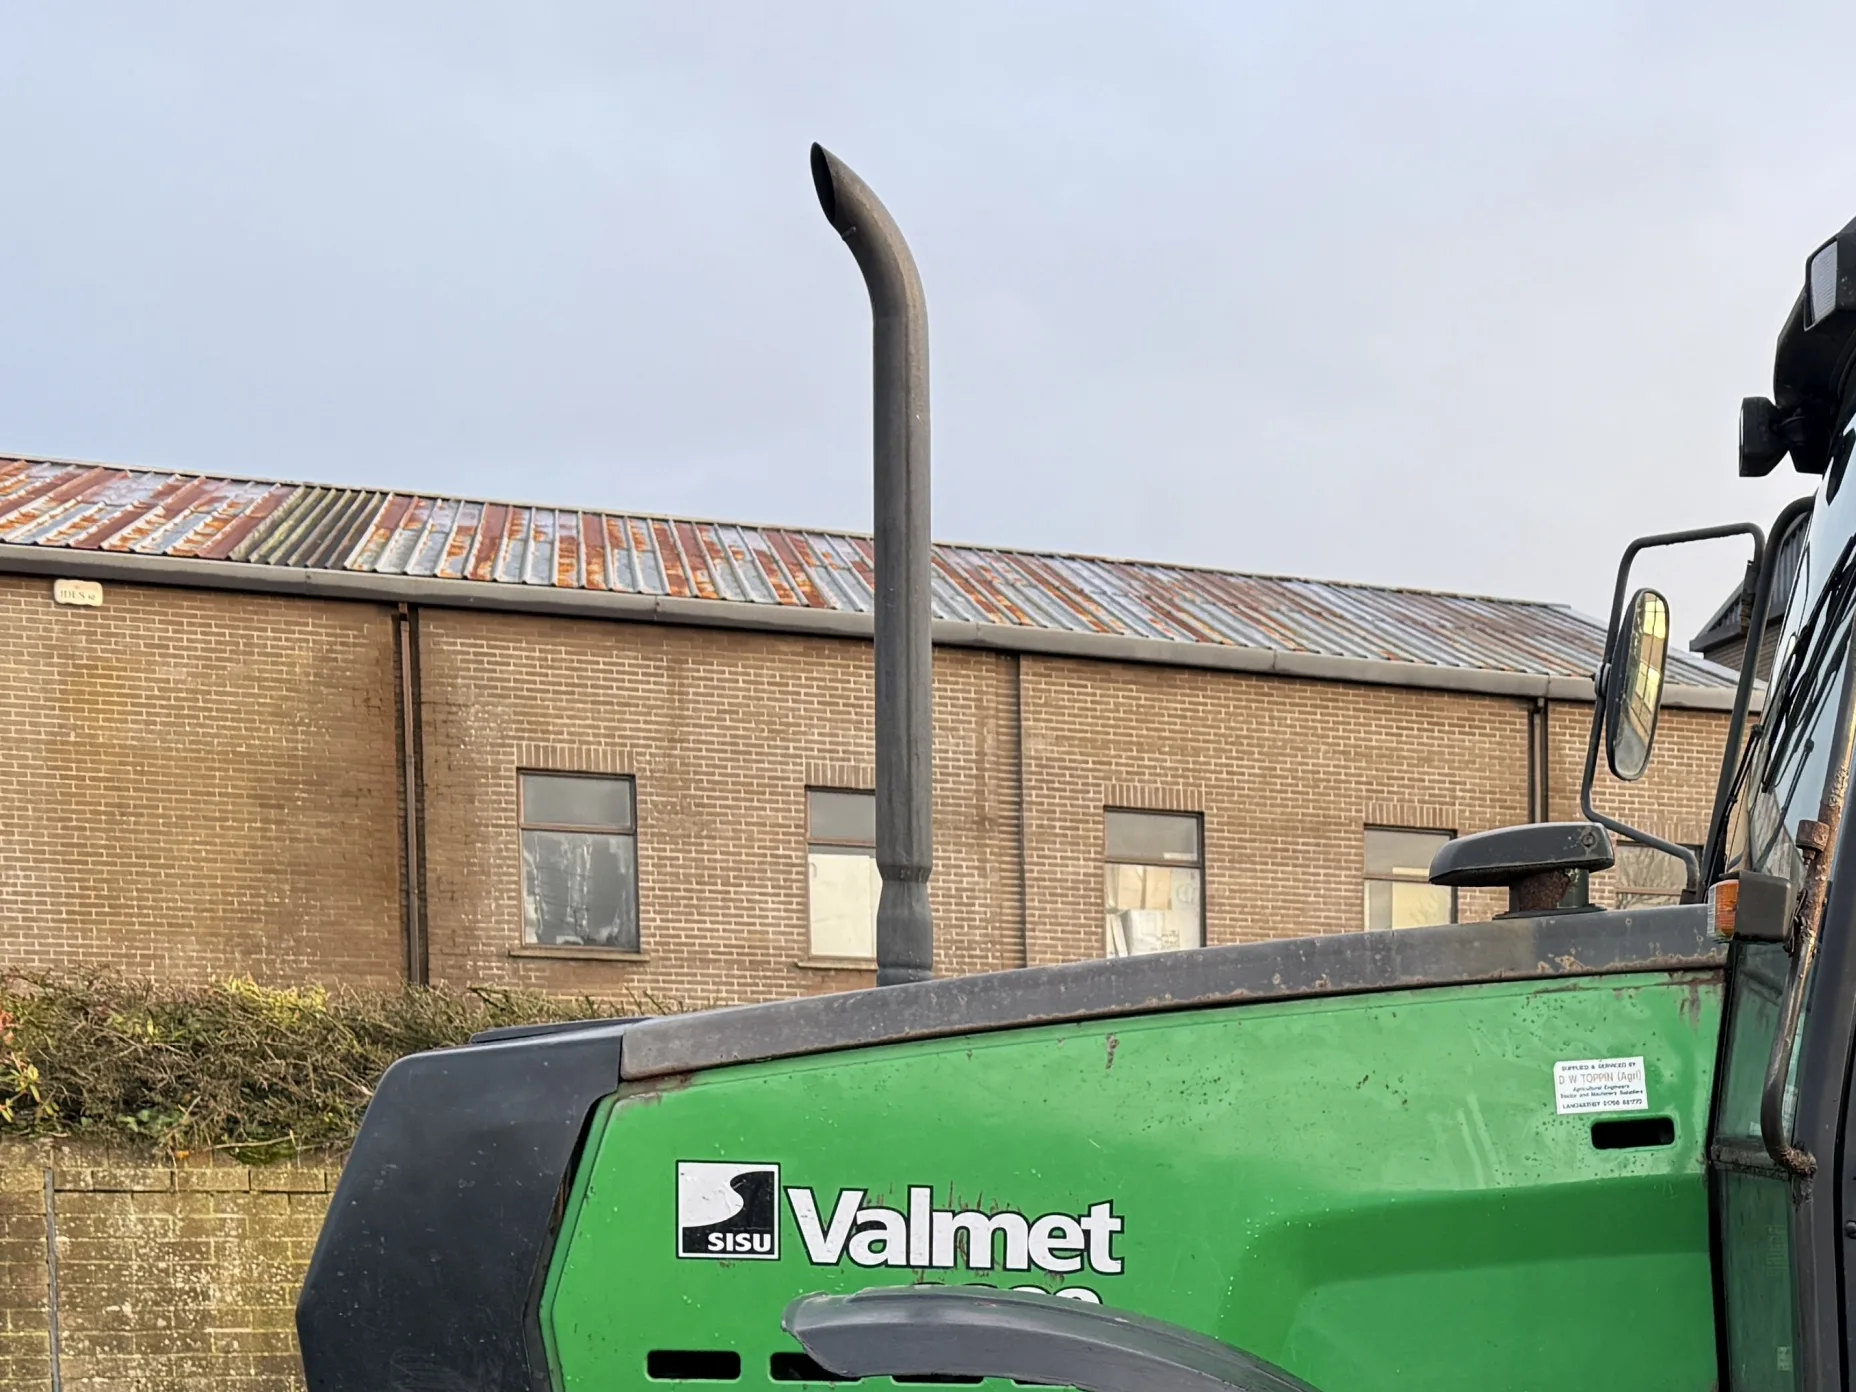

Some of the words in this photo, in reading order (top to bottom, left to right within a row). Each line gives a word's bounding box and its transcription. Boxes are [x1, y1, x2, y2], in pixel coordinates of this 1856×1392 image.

[1569, 1074, 1578, 1084] W
[1581, 1072, 1614, 1084] TOPPIN
[784, 1185, 1125, 1275] Valmet
[707, 1233, 771, 1253] SISU
